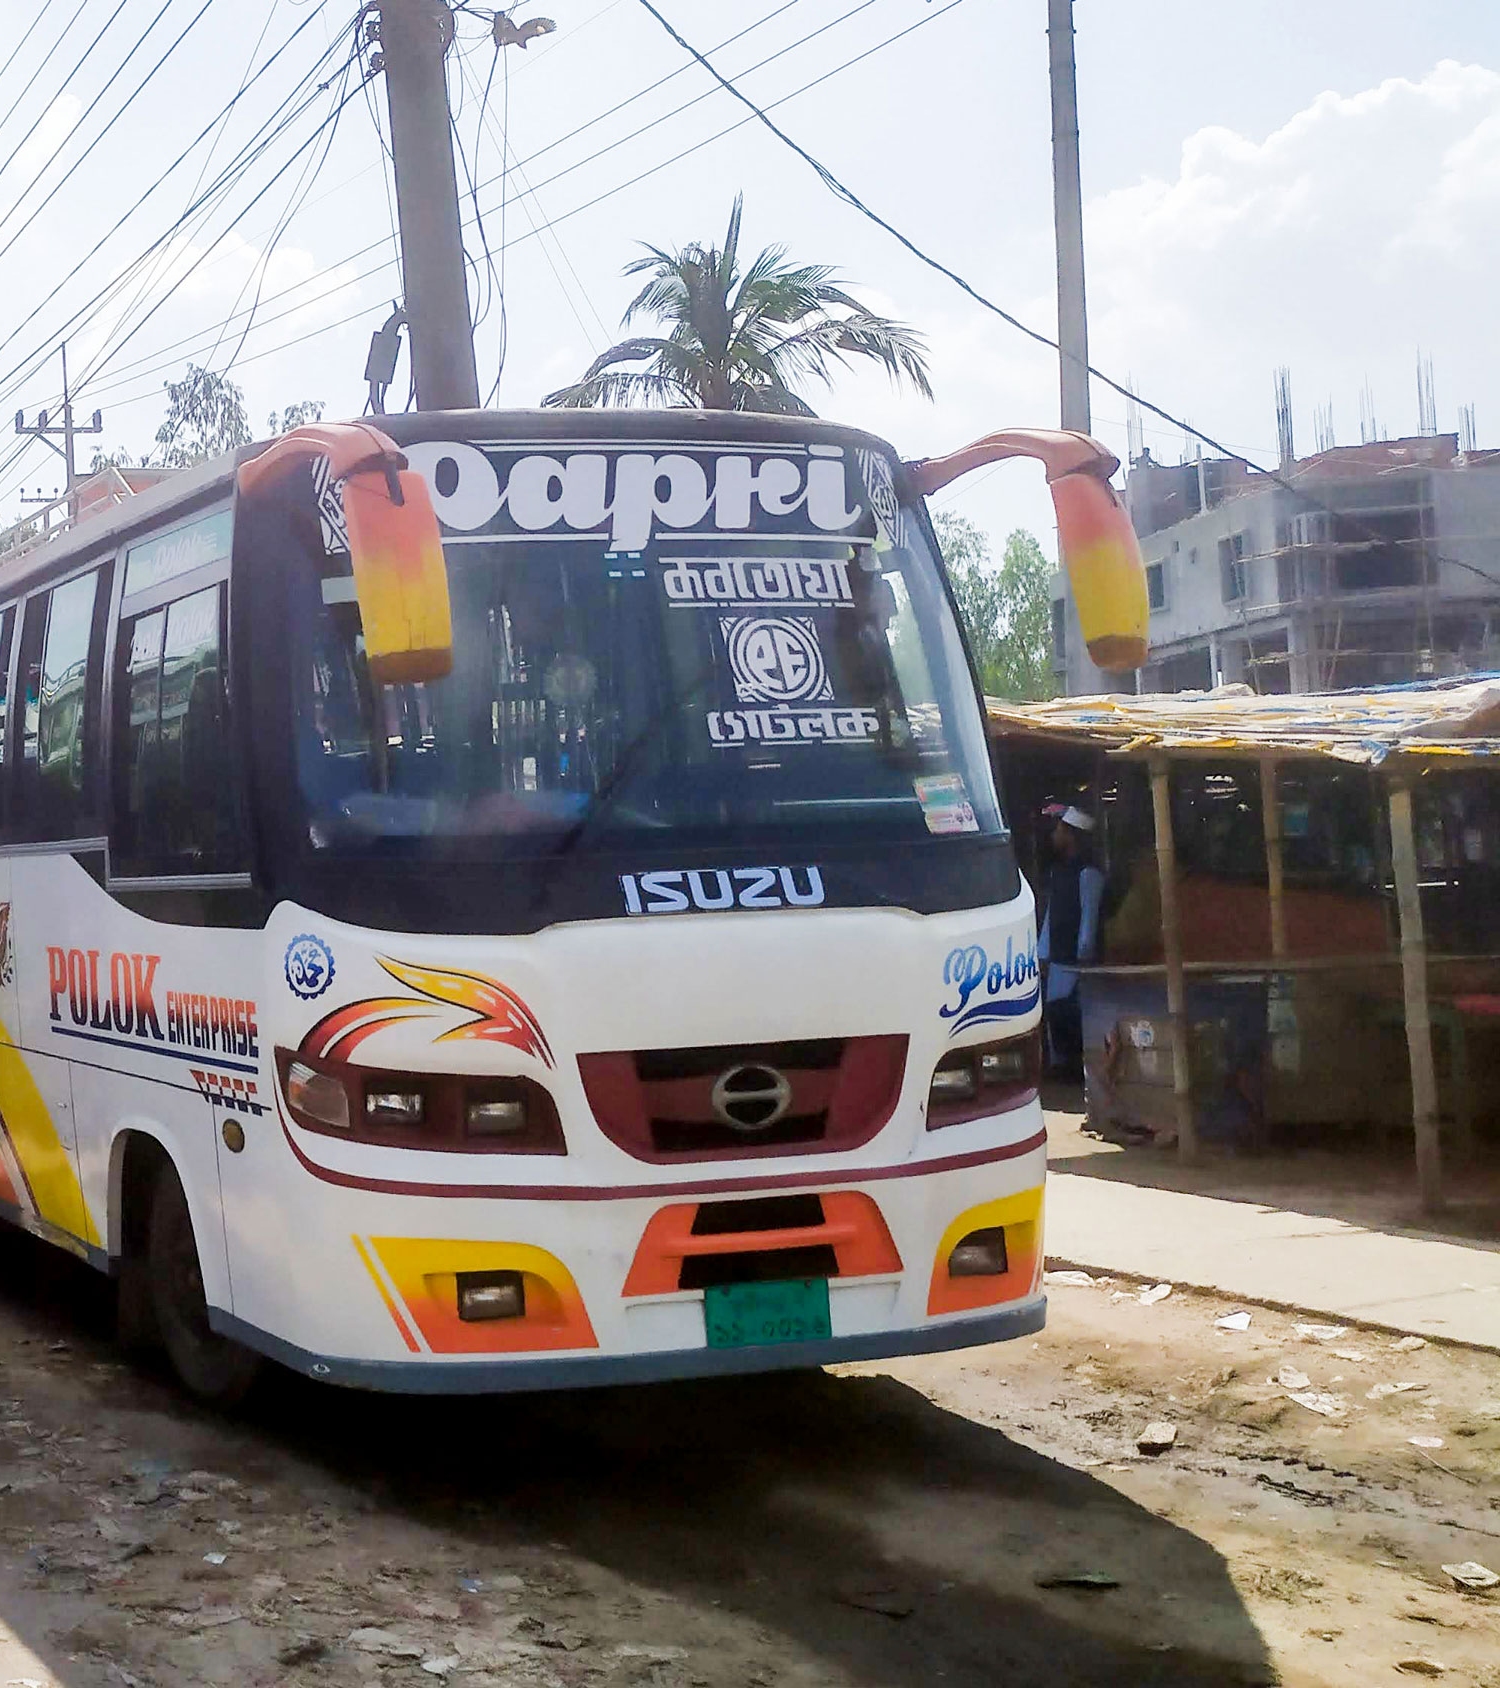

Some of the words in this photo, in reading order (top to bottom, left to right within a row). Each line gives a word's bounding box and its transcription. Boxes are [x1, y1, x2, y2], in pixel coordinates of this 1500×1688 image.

[618, 865, 826, 914] ISUZU
[46, 946, 165, 1041] POLOK
[165, 990, 260, 1059] ENTERPRISE
[939, 927, 1039, 1018] Polok
